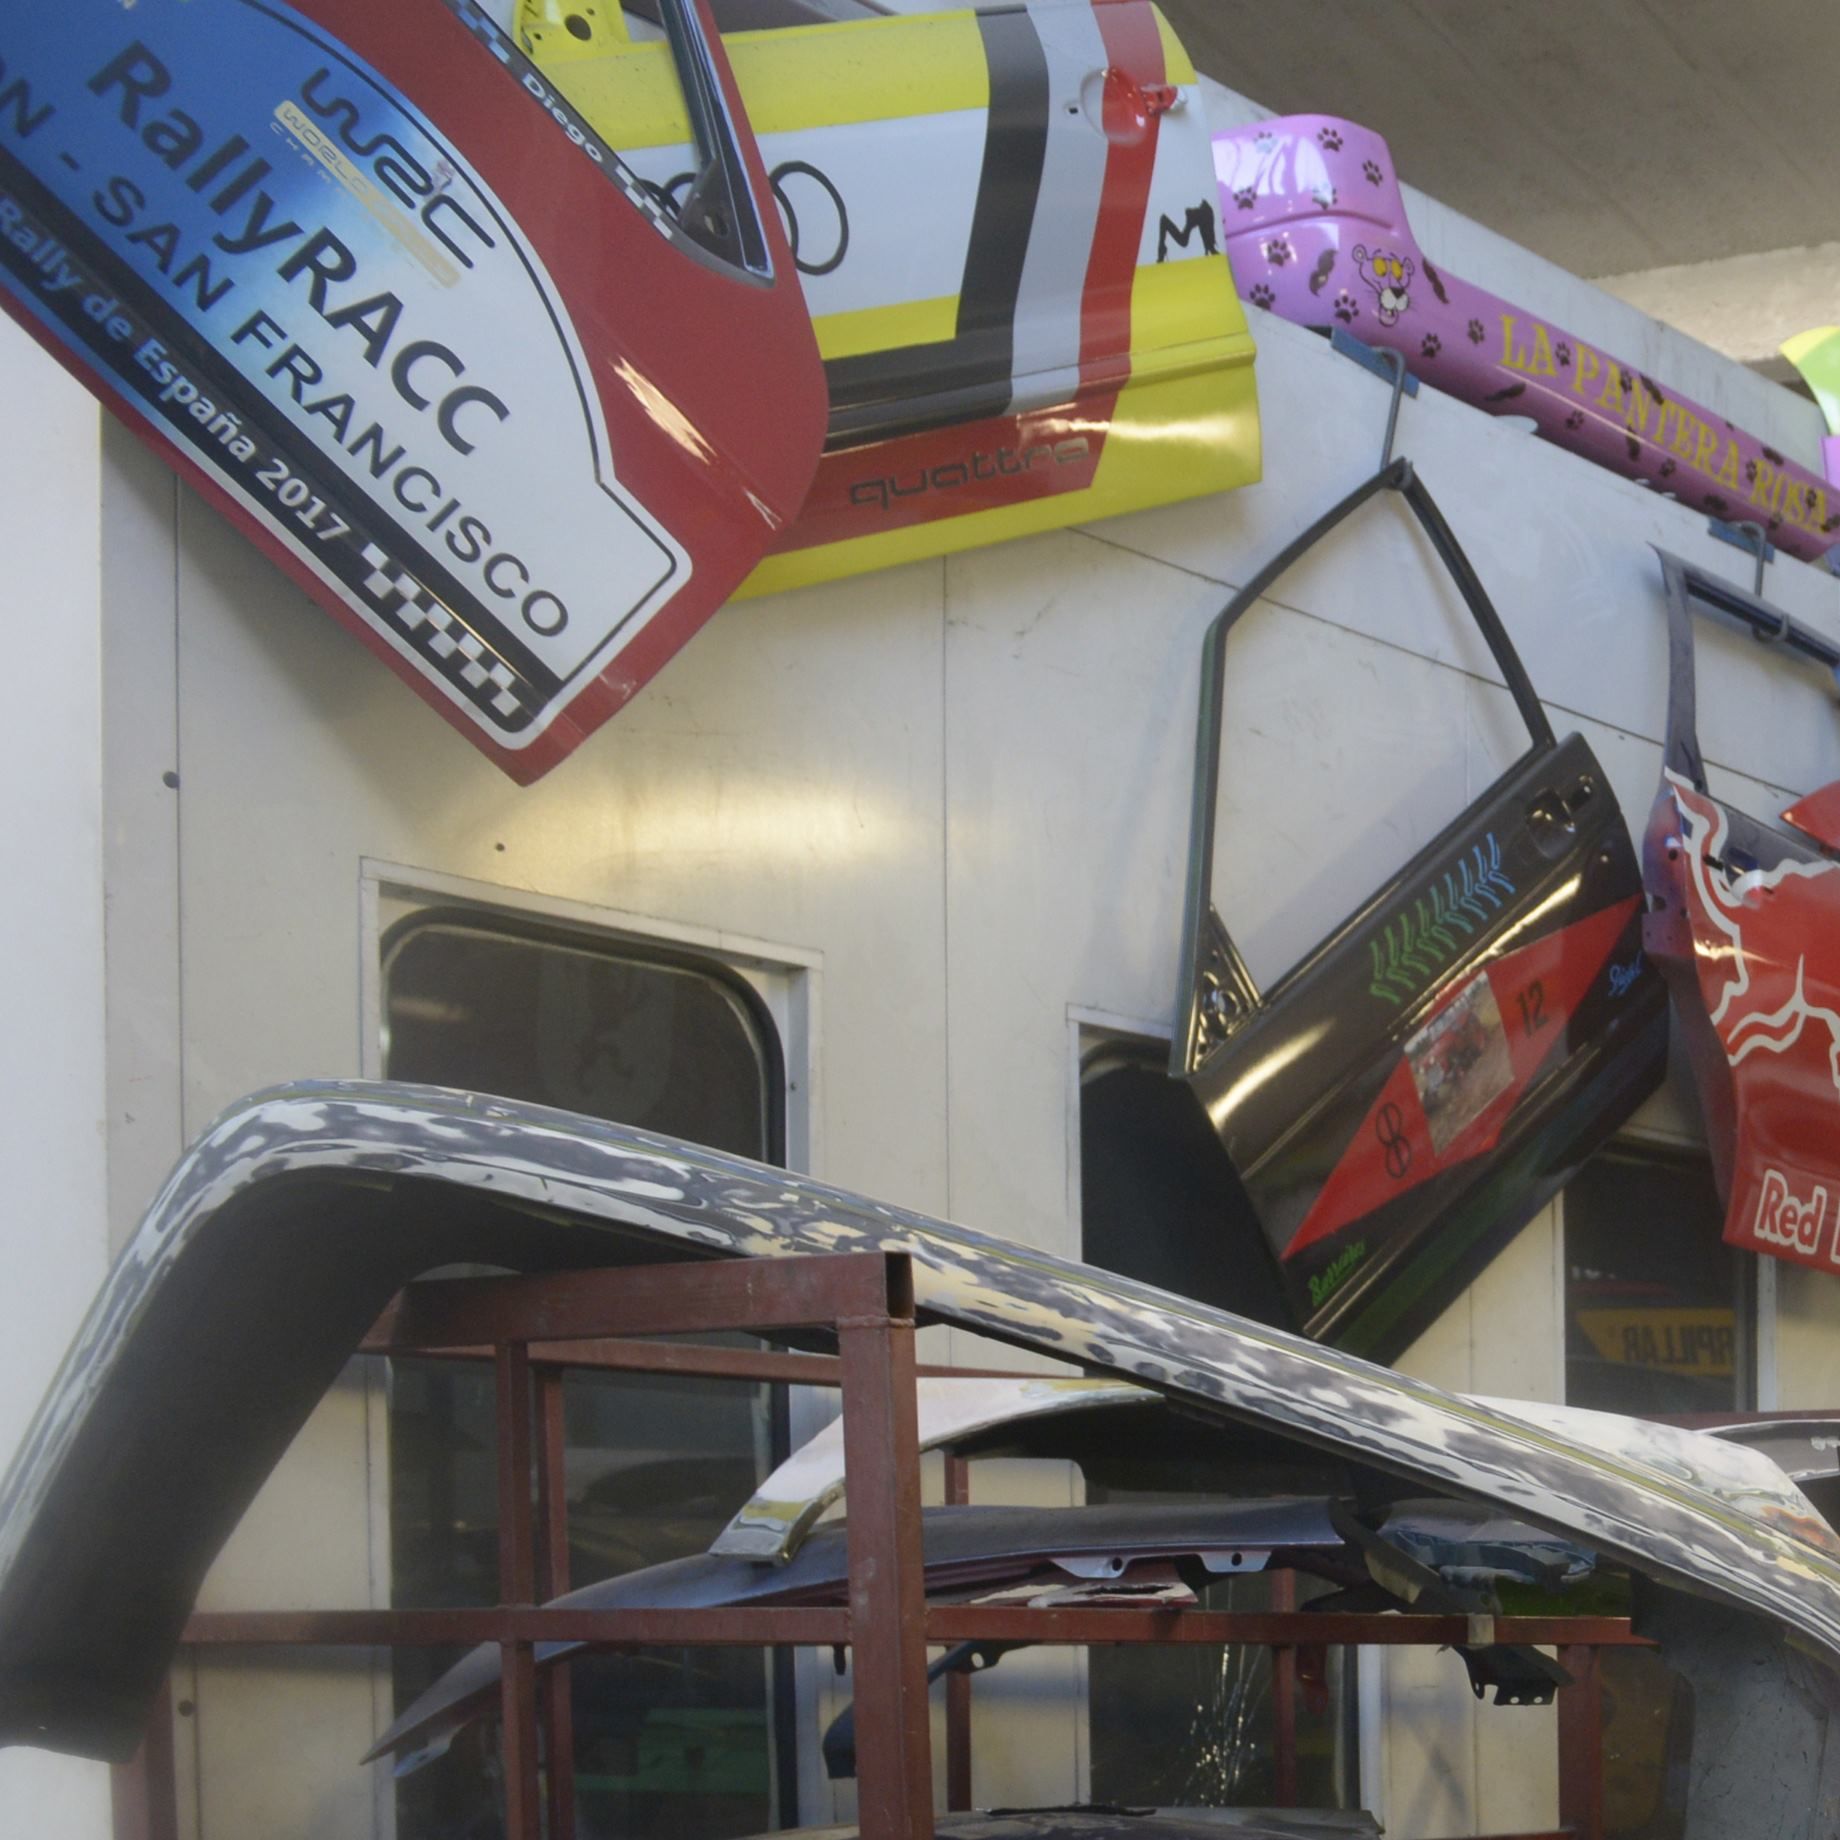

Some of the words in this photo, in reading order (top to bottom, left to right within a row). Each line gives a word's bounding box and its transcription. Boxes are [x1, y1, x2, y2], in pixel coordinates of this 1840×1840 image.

[522, 72, 603, 164] Diego
[0, 195, 82, 292] Rally
[81, 290, 136, 344] de
[132, 336, 257, 464] España
[255, 456, 352, 542] 2017
[92, 175, 235, 313] SAN
[229, 309, 569, 637] FRANCISCO
[1501, 314, 1558, 377] LA
[1569, 343, 1741, 490] PANTERA
[1749, 458, 1828, 535] ROSA
[849, 437, 1090, 508] quattro
[1516, 979, 1549, 1037] 12
[1754, 1169, 1828, 1255] Red
